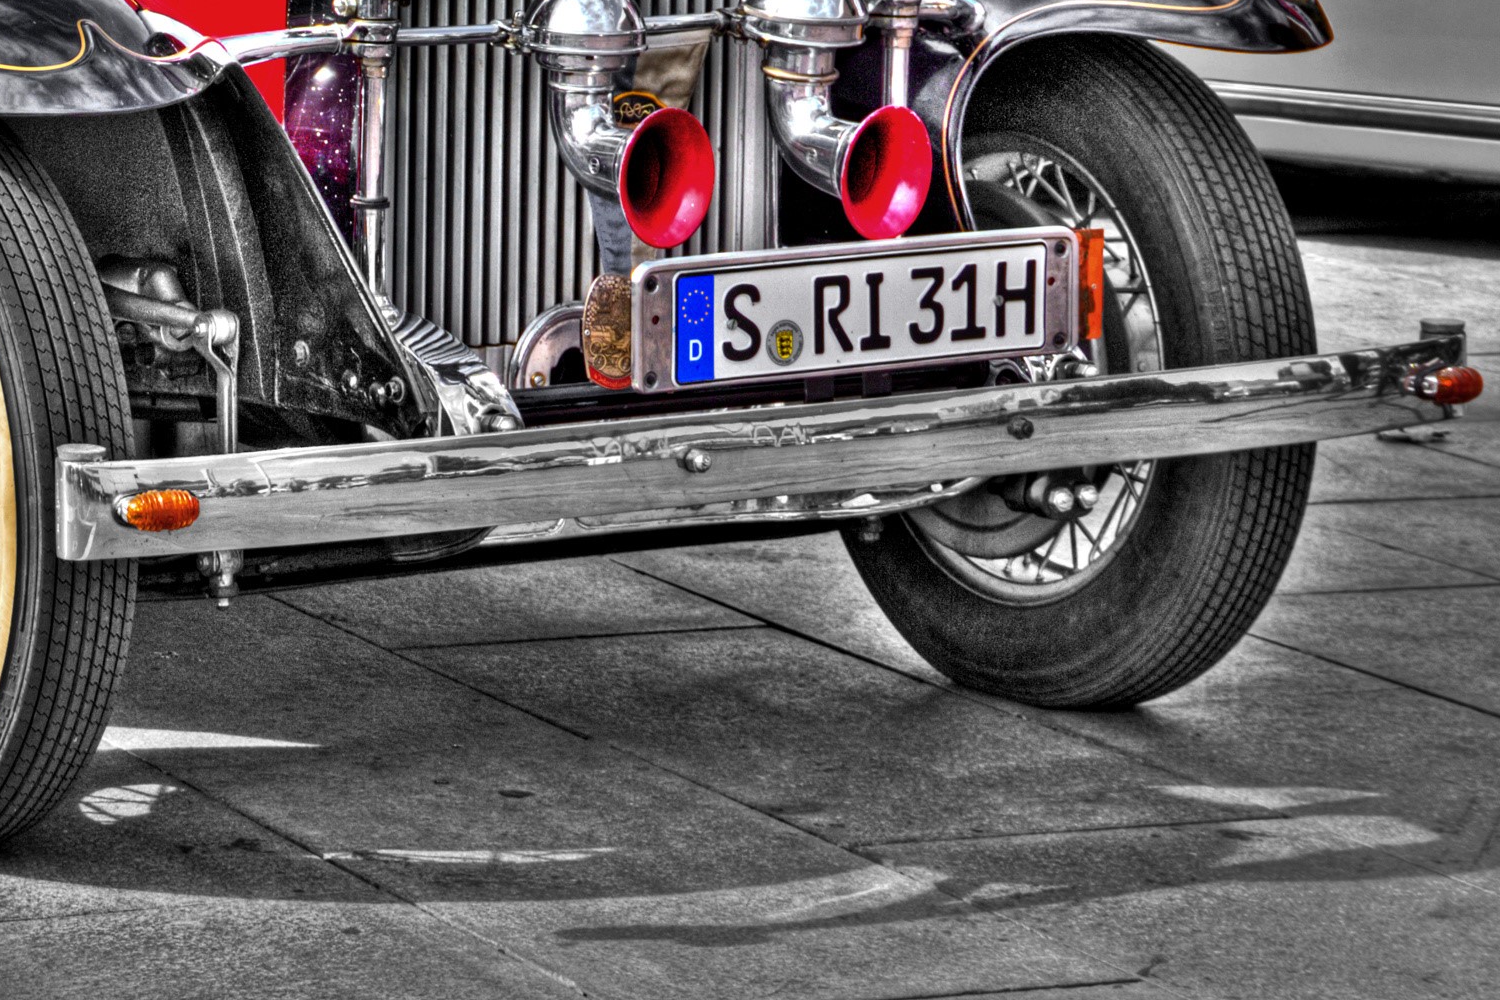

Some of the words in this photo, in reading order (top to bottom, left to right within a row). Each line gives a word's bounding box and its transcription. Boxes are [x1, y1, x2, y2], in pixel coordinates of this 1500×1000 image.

[722, 283, 762, 362] S
[813, 271, 892, 355] RI
[908, 258, 1037, 345] 31H
[688, 339, 704, 362] D
